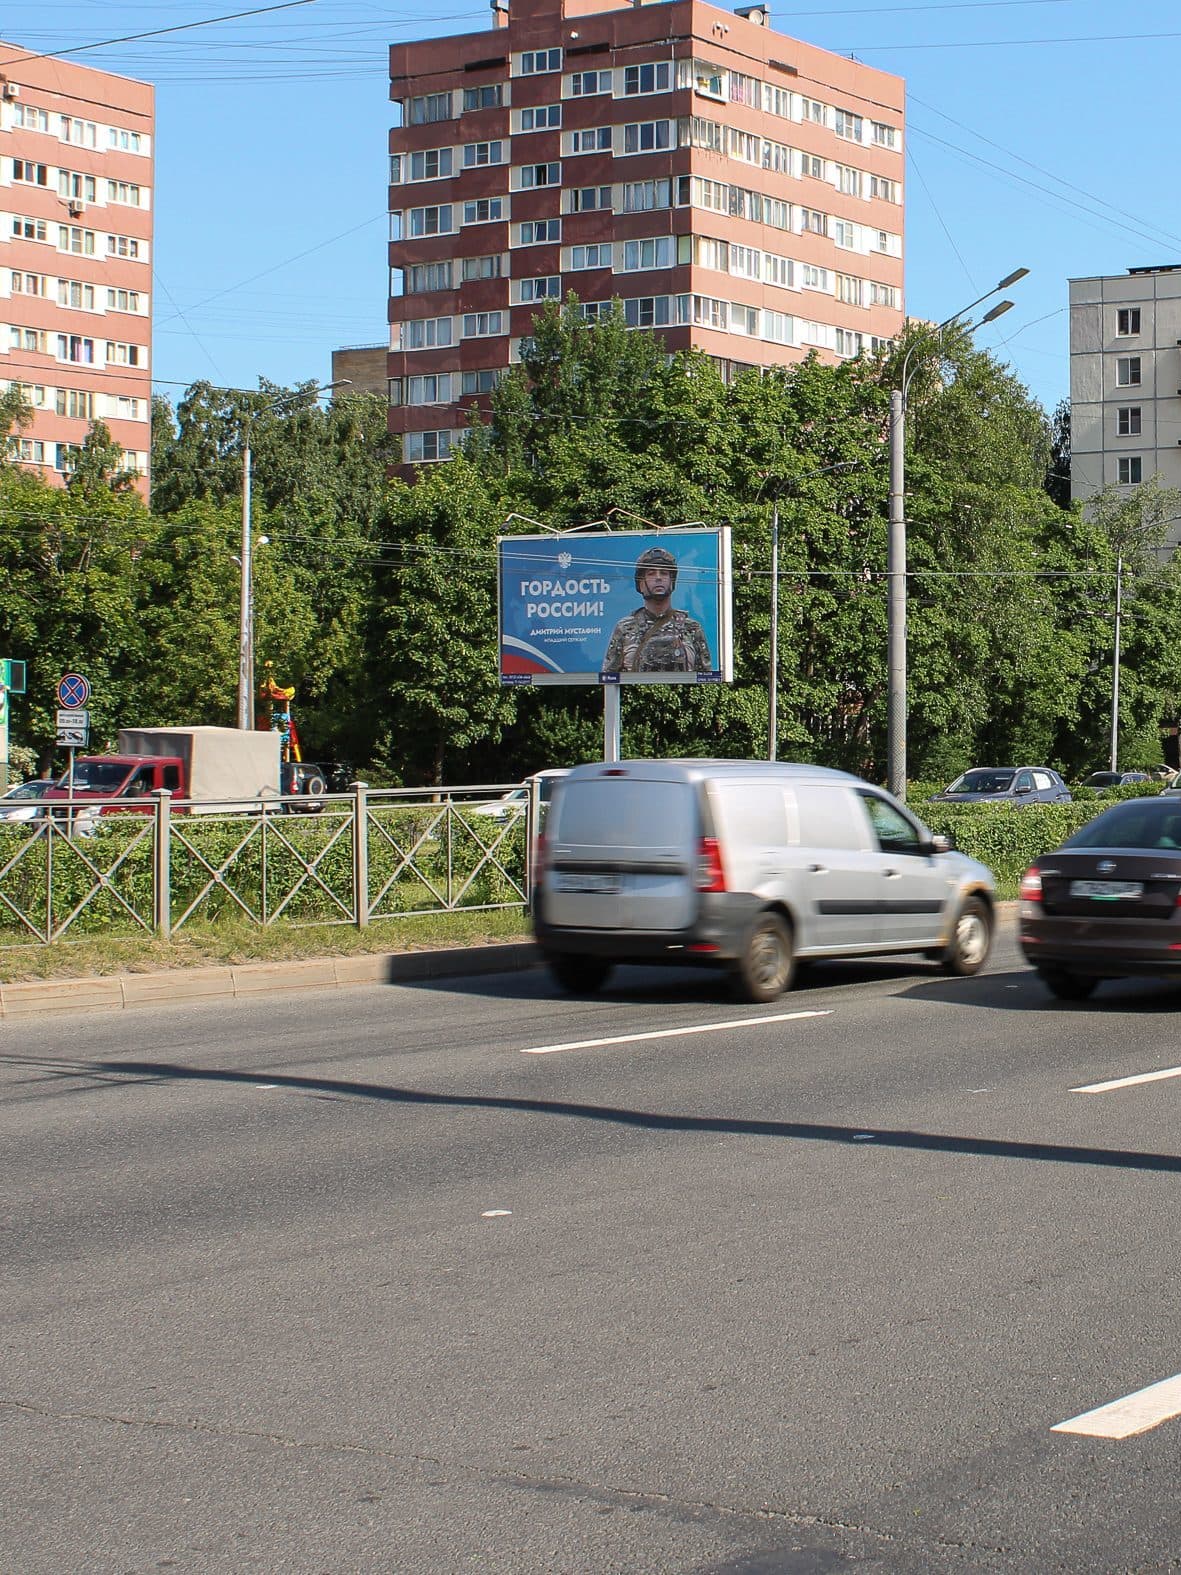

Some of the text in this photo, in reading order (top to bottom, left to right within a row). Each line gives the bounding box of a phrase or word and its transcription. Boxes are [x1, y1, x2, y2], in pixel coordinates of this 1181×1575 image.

[520, 578, 611, 597] ГОРДОСТЬ
[527, 601, 604, 618] РОССИИ!
[530, 626, 602, 636] ДМИТРИЙ МУСТАФИН
